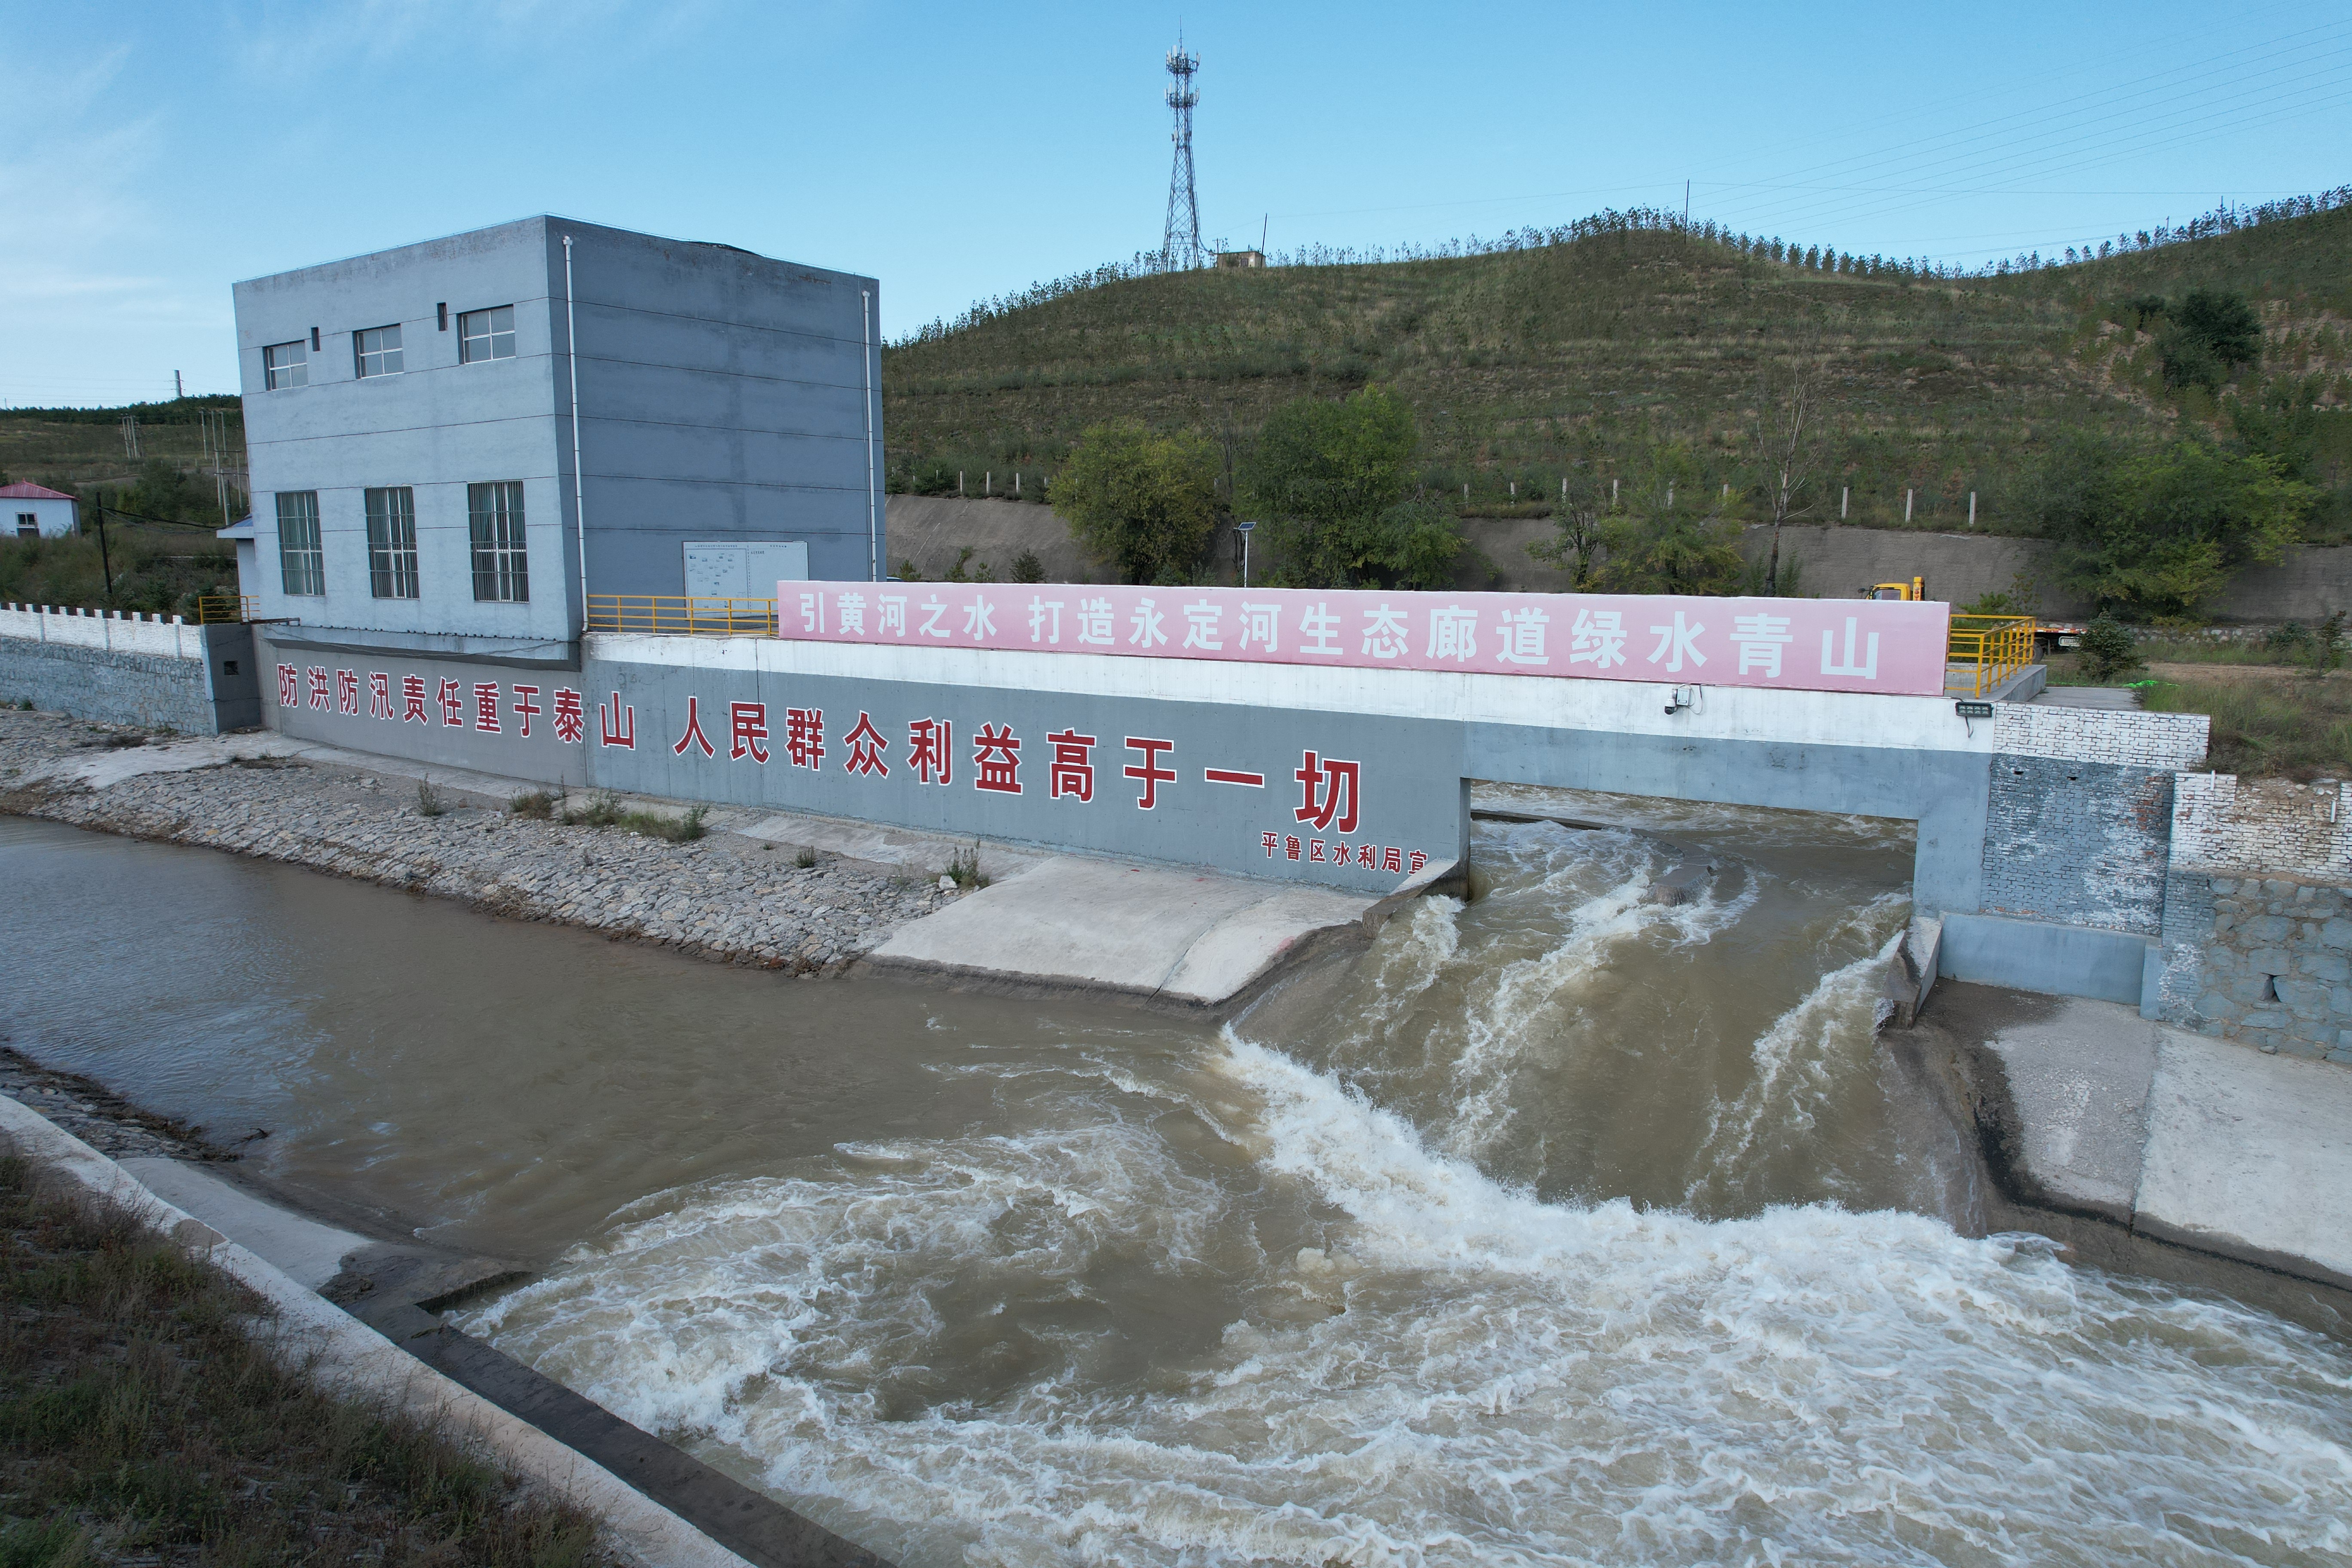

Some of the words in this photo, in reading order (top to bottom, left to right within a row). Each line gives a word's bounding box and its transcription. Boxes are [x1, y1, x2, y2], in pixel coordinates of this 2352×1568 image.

[800, 592, 997, 641] 引黄河之水
[1028, 595, 1880, 680] 打造永定河生态廊道绿水青山
[277, 662, 636, 750] 防洪防汛责任重于泰山
[672, 695, 1360, 834] 人民群众利益高于一切
[1261, 831, 1428, 875] 平鲁区水利局宣
